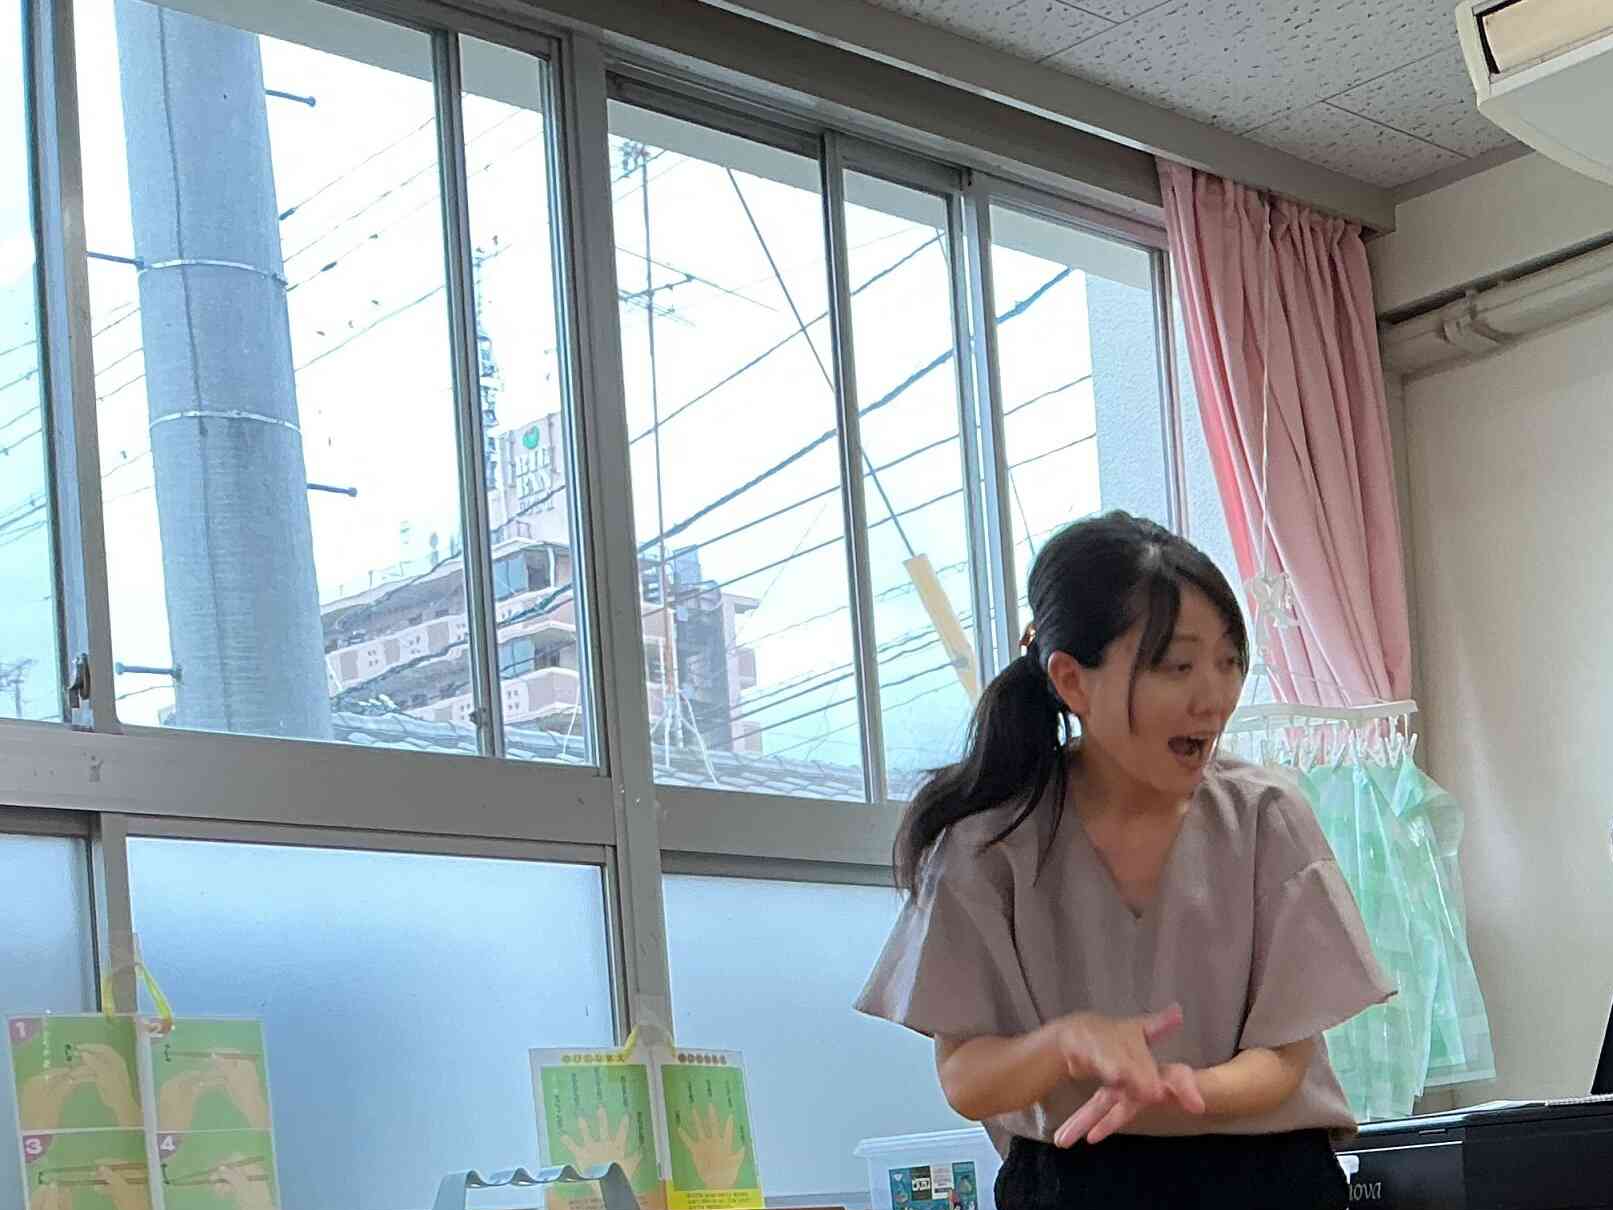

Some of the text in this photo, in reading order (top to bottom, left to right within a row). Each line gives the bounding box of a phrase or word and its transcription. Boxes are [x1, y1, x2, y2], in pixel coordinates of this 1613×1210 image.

[15, 1021, 27, 1038] 1
[25, 1138, 42, 1154] 3
[160, 1137, 175, 1151] 4
